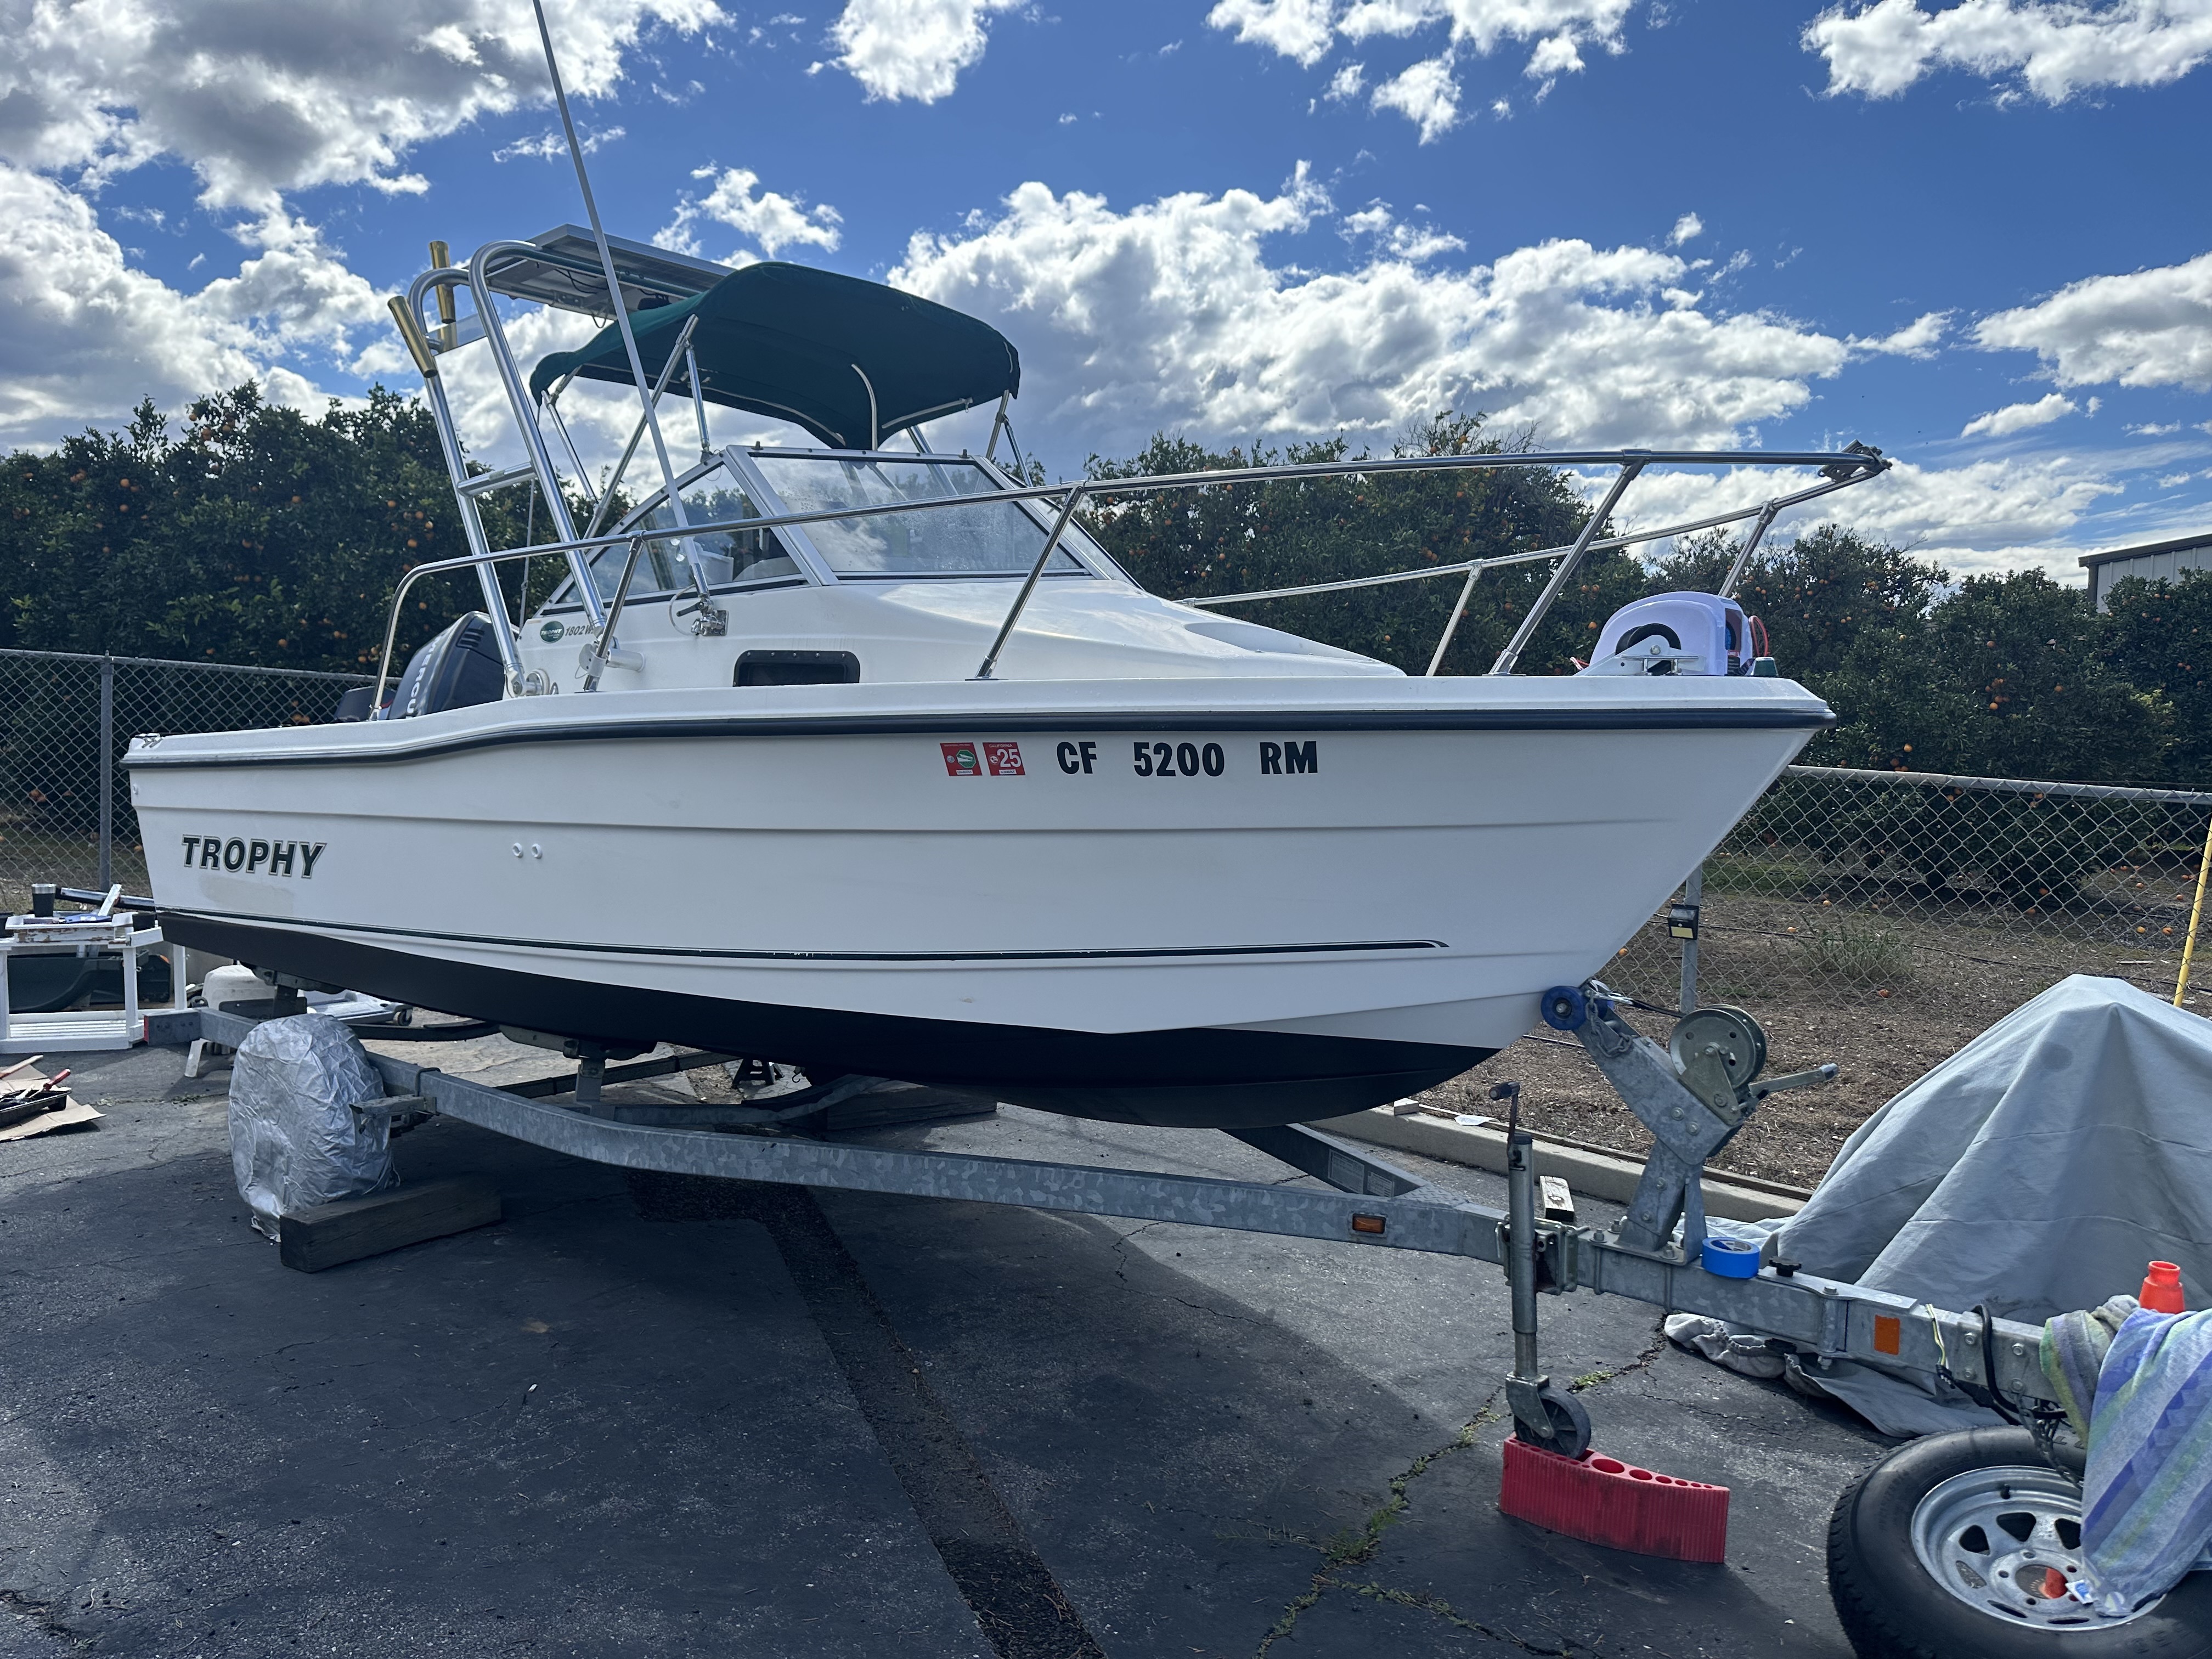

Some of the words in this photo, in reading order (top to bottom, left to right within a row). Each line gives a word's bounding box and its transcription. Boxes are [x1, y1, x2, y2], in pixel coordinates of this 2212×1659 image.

[565, 626, 585, 636] 1802
[997, 749, 1022, 768] 25
[1057, 741, 1097, 774] CF
[1133, 742, 1225, 777] 5200
[1260, 741, 1318, 774] RM
[182, 834, 328, 879] TROPHY
